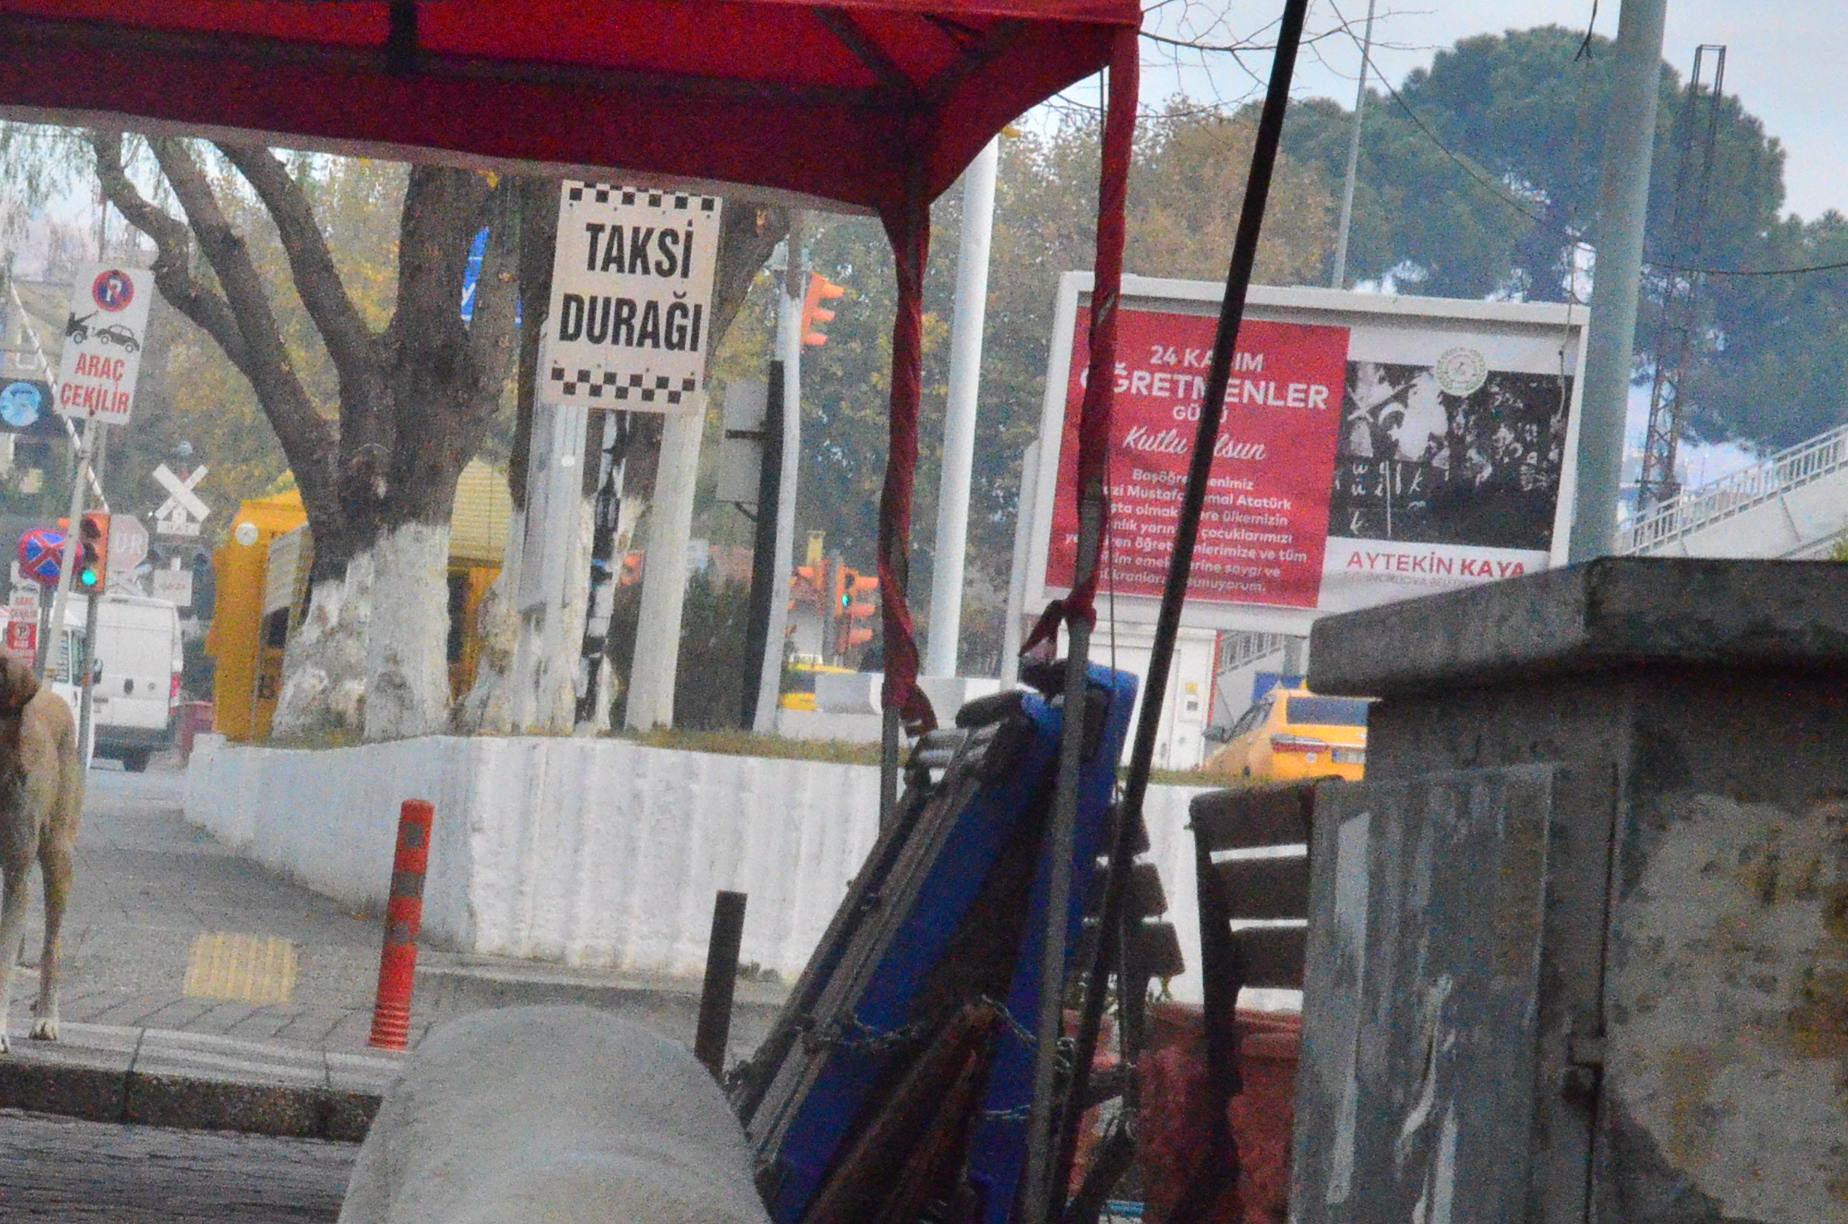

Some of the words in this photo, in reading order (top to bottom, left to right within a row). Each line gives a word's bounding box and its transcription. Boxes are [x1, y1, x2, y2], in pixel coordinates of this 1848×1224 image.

[585, 219, 694, 279] TAKSİ
[559, 291, 703, 352] DURAĞI
[74, 352, 126, 382] ARAÇ
[1150, 344, 1178, 365] 24
[1184, 350, 1265, 373] KAIM
[60, 382, 130, 414] ÇEKİLİR
[1121, 425, 1189, 456] Kutlu
[1212, 432, 1267, 462] lsun
[1135, 503, 1179, 518] olmak
[1236, 494, 1292, 511] Atatürk
[1278, 548, 1308, 563] tüm
[1347, 551, 1453, 575] AYTEKİN
[1460, 557, 1525, 578] KAYA
